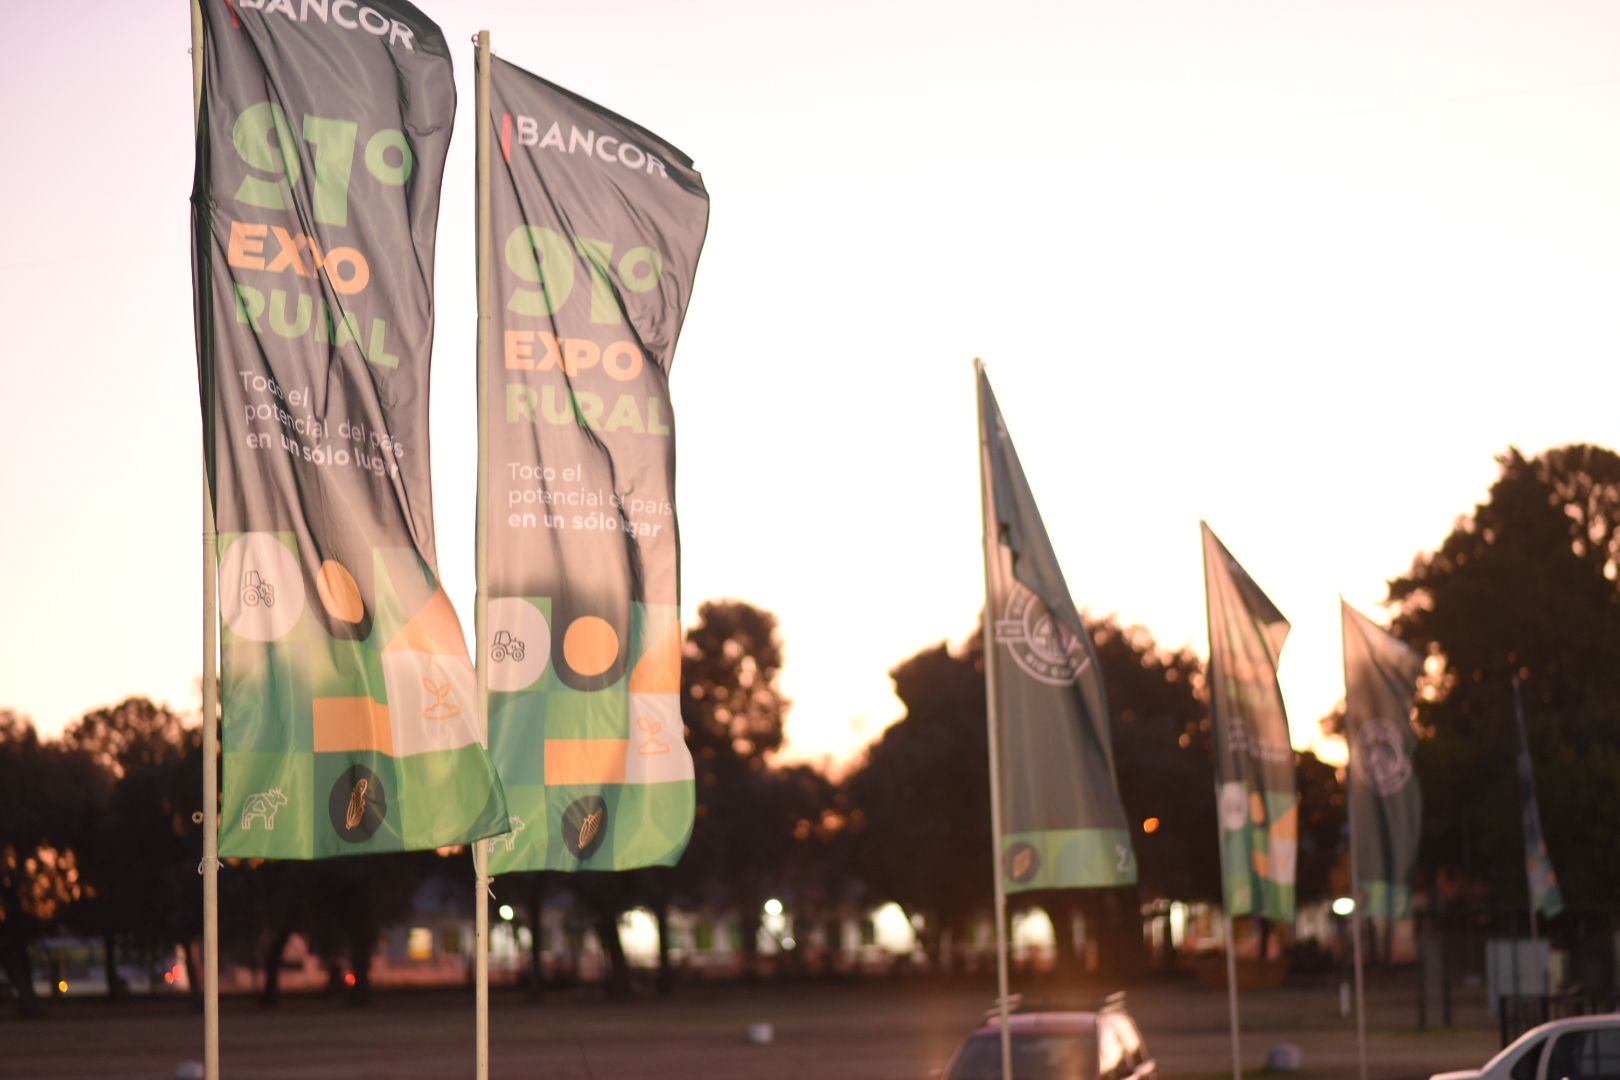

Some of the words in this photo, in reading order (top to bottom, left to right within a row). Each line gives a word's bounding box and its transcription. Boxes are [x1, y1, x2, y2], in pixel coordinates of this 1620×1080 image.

[516, 114, 669, 179] BANCOR
[227, 221, 370, 295] EXO
[504, 330, 644, 381] EXPO
[288, 386, 309, 408] el
[506, 383, 670, 436] RURAL
[244, 403, 329, 440] potencial
[338, 418, 366, 443] del
[246, 432, 272, 449] en
[280, 433, 300, 457] un
[302, 443, 350, 467] sólo
[562, 464, 582, 482] el
[508, 487, 603, 509] potencial
[630, 498, 673, 517] país
[508, 513, 537, 528] en
[543, 514, 565, 528] un
[572, 511, 617, 531] sólo
